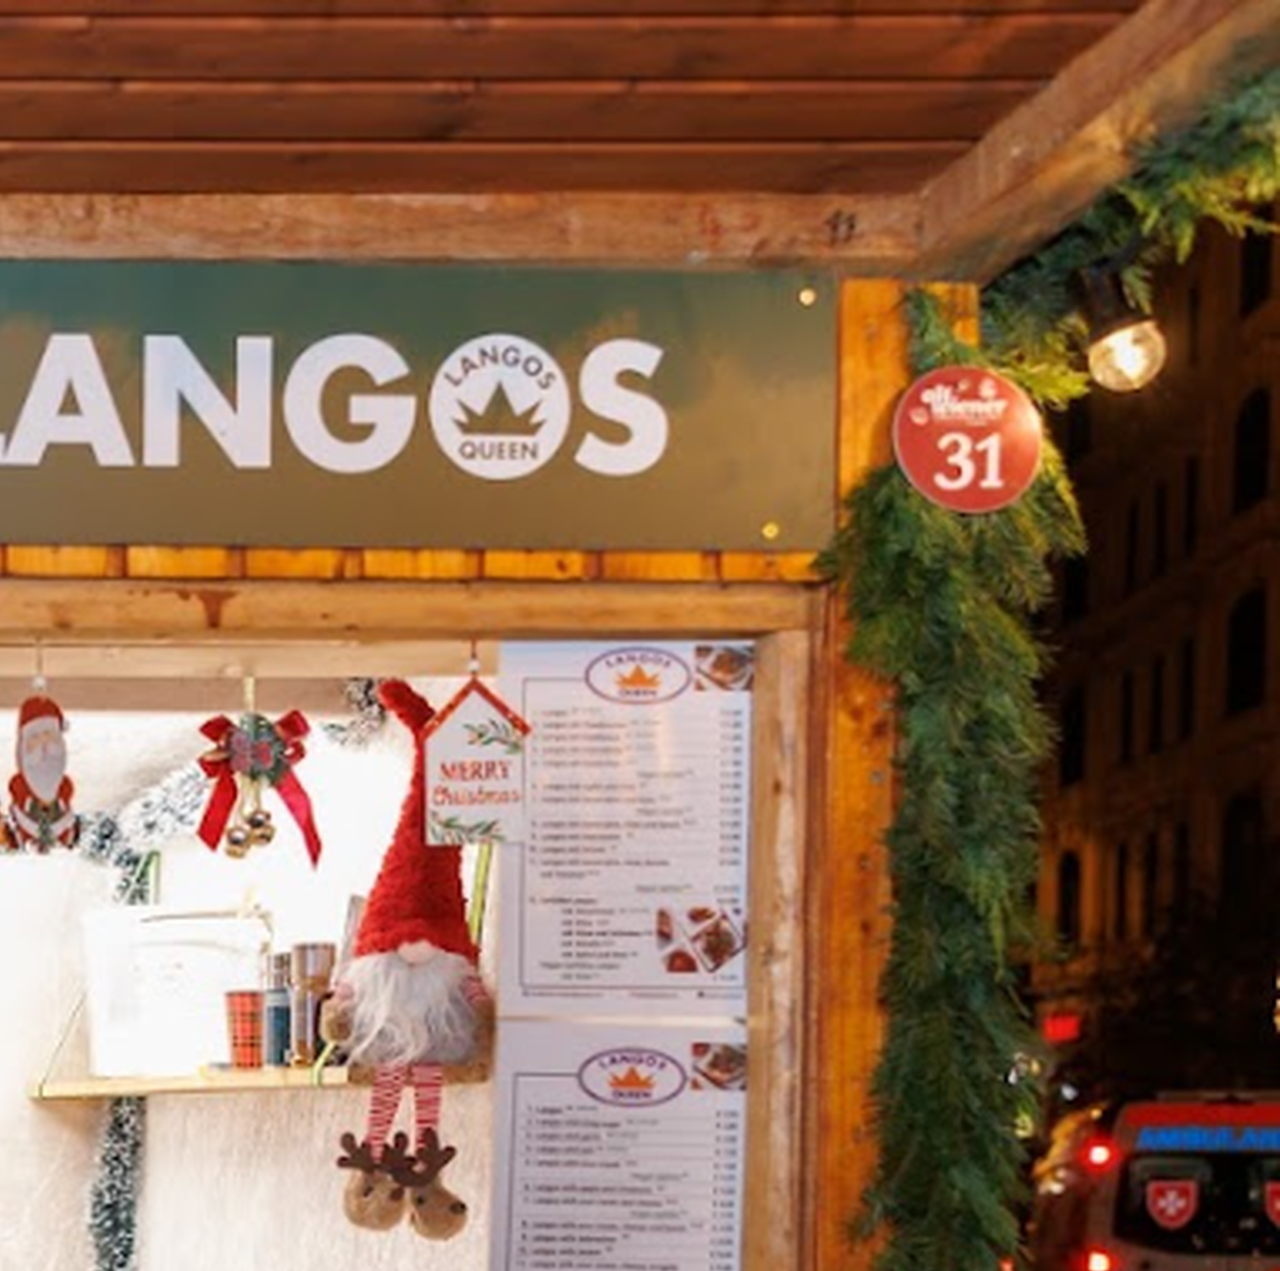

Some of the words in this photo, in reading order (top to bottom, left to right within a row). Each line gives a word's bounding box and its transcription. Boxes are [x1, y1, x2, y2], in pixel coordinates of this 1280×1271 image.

[443, 345, 557, 391] LANGOS
[458, 440, 540, 461] QUEEN
[933, 431, 1006, 491] 31
[441, 760, 512, 782] MERRY
[433, 783, 522, 806] Christmas
